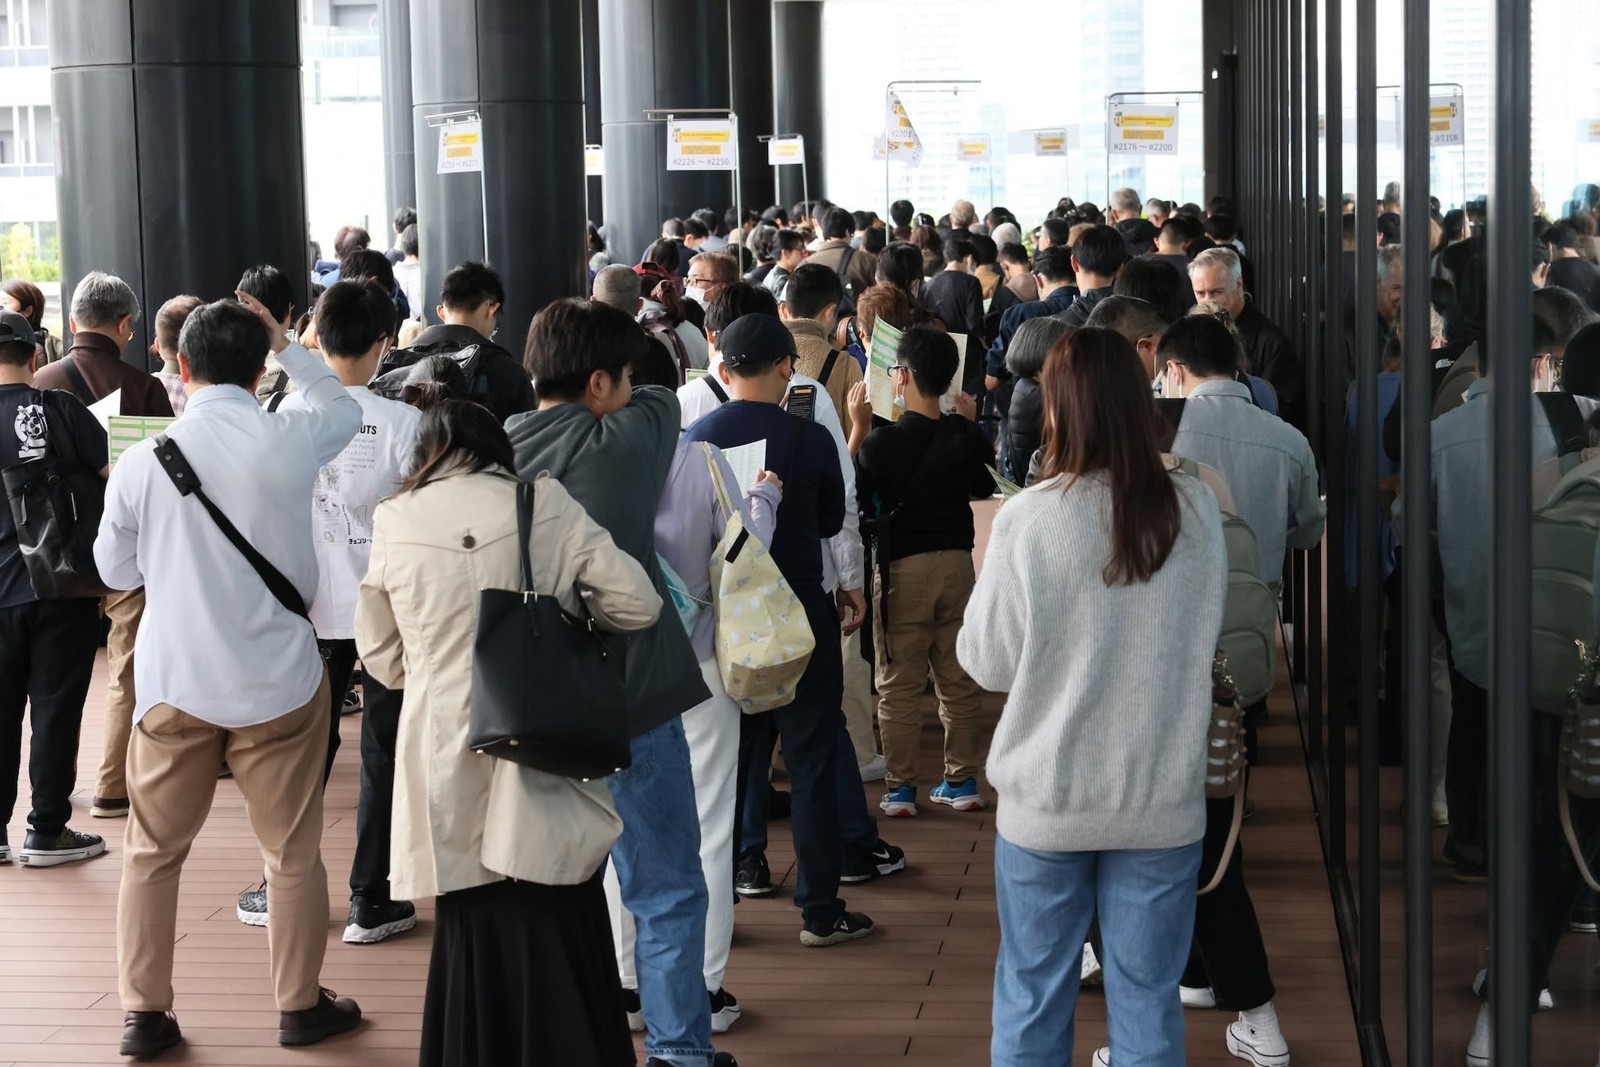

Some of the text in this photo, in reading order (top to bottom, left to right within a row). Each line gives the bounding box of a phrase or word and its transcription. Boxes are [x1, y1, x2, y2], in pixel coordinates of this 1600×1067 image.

[673, 158, 696, 166] #2226
[707, 158, 730, 166] #2250
[358, 425, 378, 435] UTS
